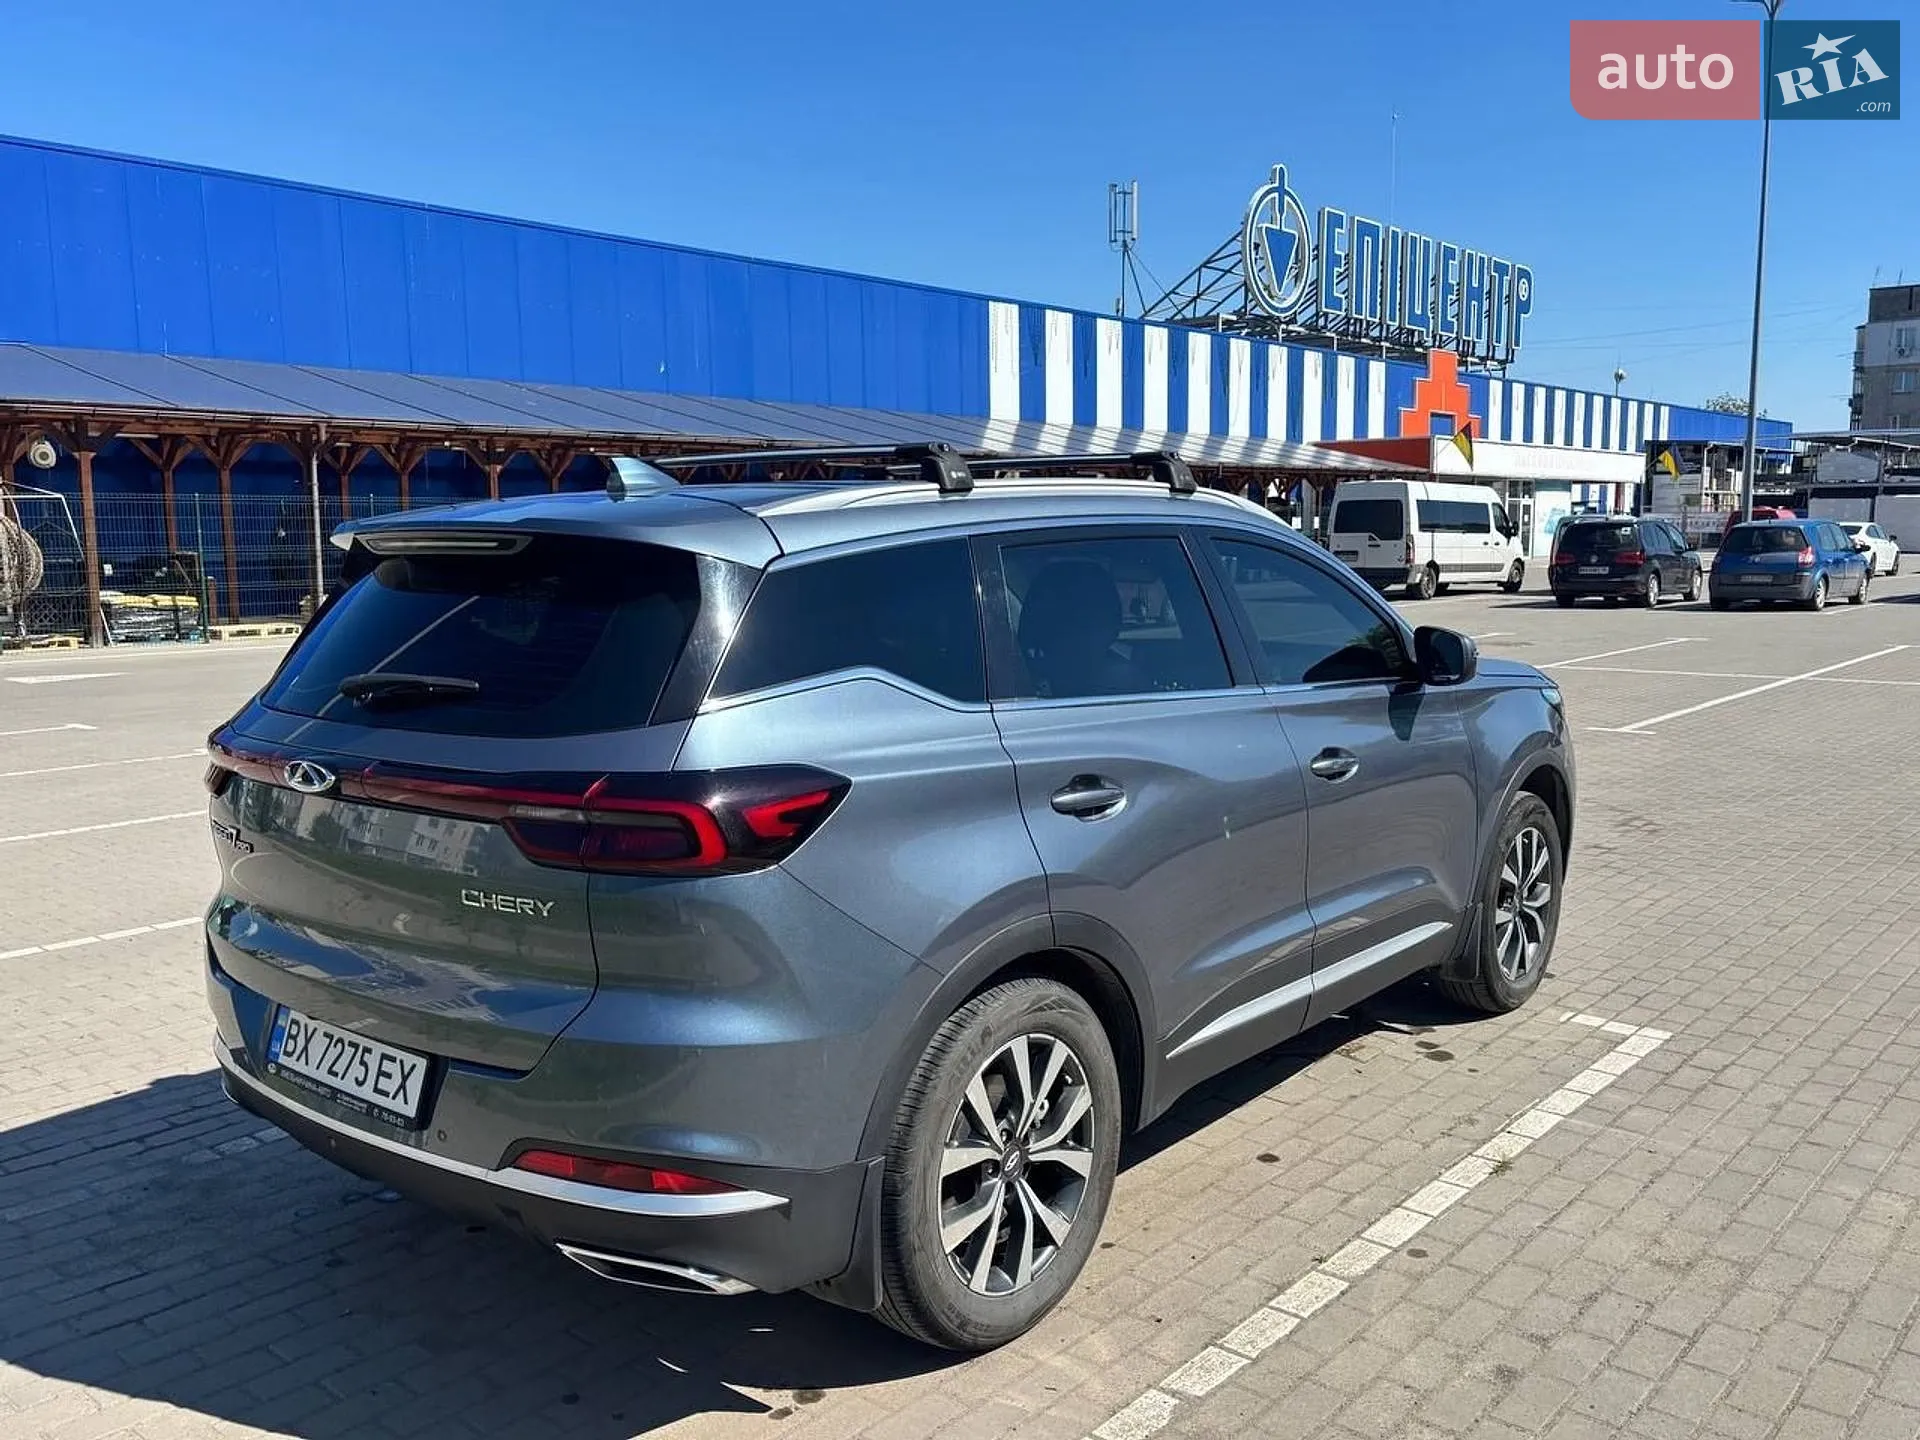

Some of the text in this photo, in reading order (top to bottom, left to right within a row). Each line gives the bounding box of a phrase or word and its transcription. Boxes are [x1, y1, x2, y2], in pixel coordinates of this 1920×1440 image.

[1319, 207, 1535, 350] ЕПІЦЕНТР
[461, 889, 555, 917] CHERY
[282, 1018, 318, 1067] BX
[316, 1031, 373, 1087] 7275
[372, 1052, 417, 1106] EX
